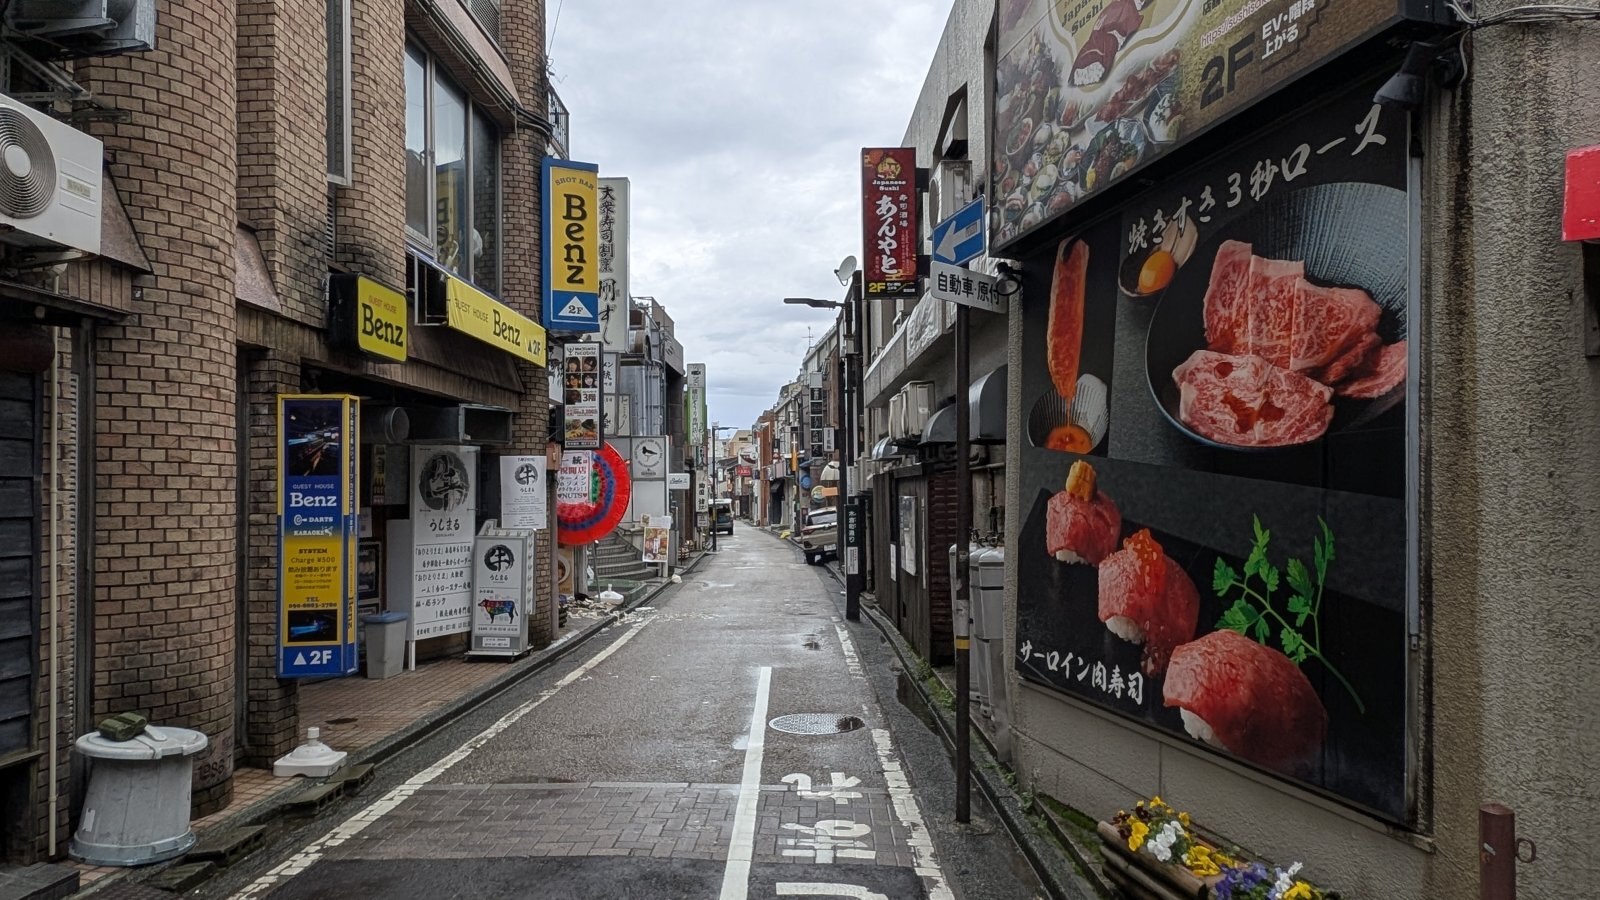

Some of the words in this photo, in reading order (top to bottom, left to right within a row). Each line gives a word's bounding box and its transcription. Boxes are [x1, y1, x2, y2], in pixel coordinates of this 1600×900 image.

[1261, 24, 1298, 60] 上がる
[1201, 33, 1256, 108] 2F
[555, 177, 578, 185] SHOT
[579, 177, 594, 191] BAR
[1128, 104, 1388, 252] 焼きすき3秒ロース
[563, 194, 587, 284] Benz
[876, 194, 898, 274] あんやと
[368, 295, 382, 308] GUEST
[383, 300, 397, 315] HOUSE
[868, 283, 886, 293] 2F
[937, 270, 1000, 305] 自動車・原付
[362, 303, 403, 347] Benz
[454, 298, 471, 317] GUEST
[472, 310, 489, 323] HOUSE
[568, 305, 583, 314] 2F
[493, 308, 521, 347] Benz
[532, 339, 541, 357] 2F
[290, 492, 337, 507] Benz
[429, 517, 460, 532] うしまる
[310, 651, 332, 665] 2F
[1020, 639, 1143, 705] サーロイン肉寿司
